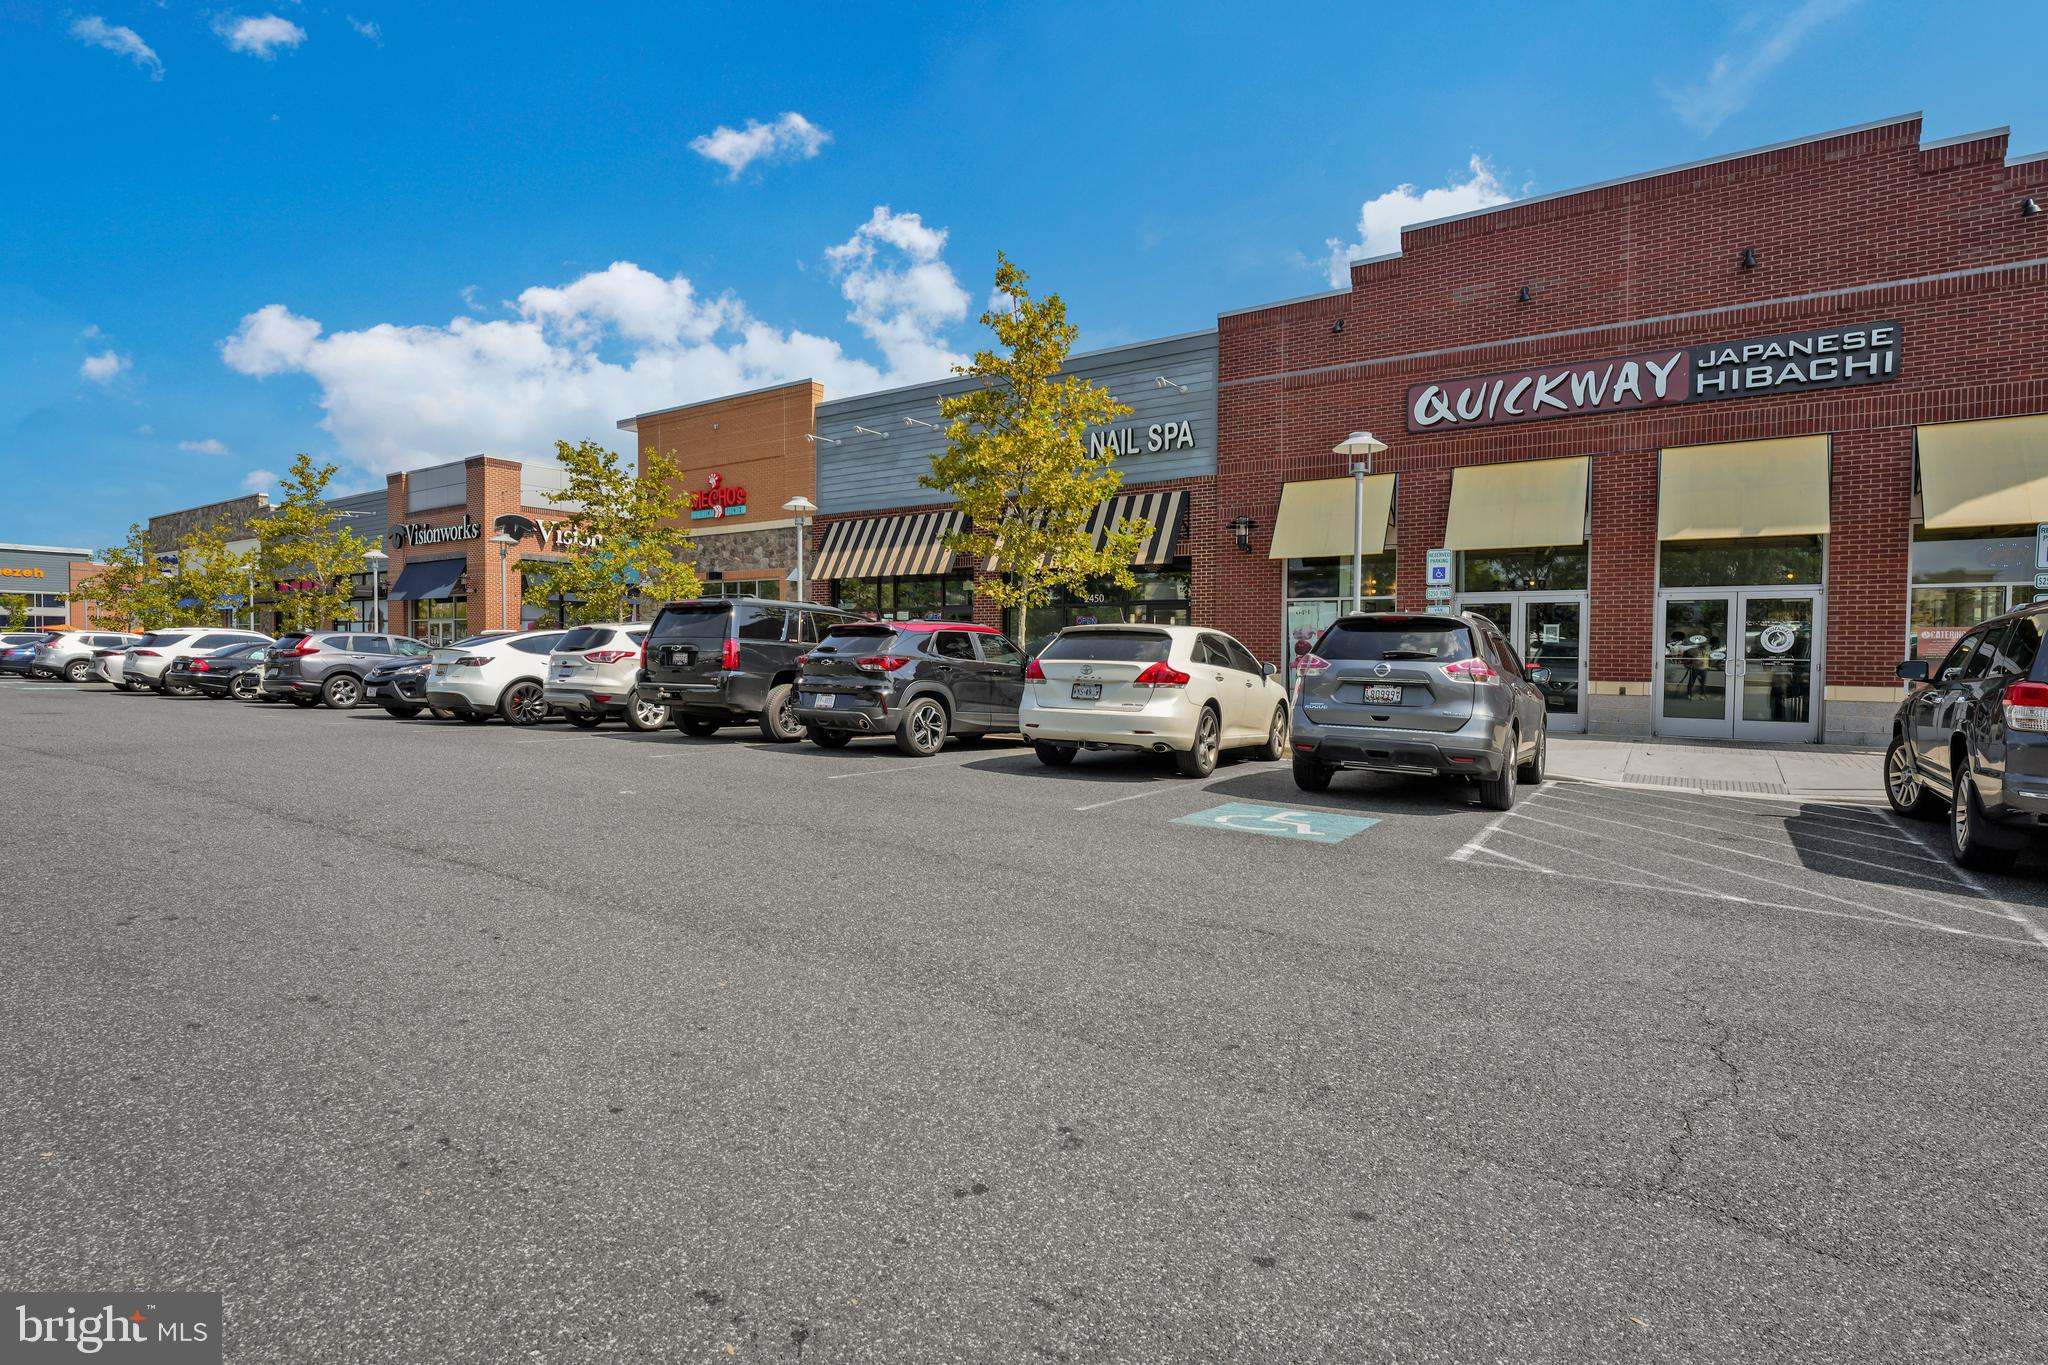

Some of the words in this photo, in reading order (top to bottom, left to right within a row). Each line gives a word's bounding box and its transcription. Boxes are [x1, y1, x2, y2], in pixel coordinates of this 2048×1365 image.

[1698, 327, 1894, 368] JAPANESE
[1413, 351, 1682, 426] QUICKWAY
[1696, 351, 1894, 394] HIBACHI
[1090, 427, 1141, 459] NAIL
[1147, 420, 1195, 452] SPA
[401, 514, 480, 546] Visionworks
[535, 518, 604, 548] Vision
[0, 566, 45, 578] ezeh
